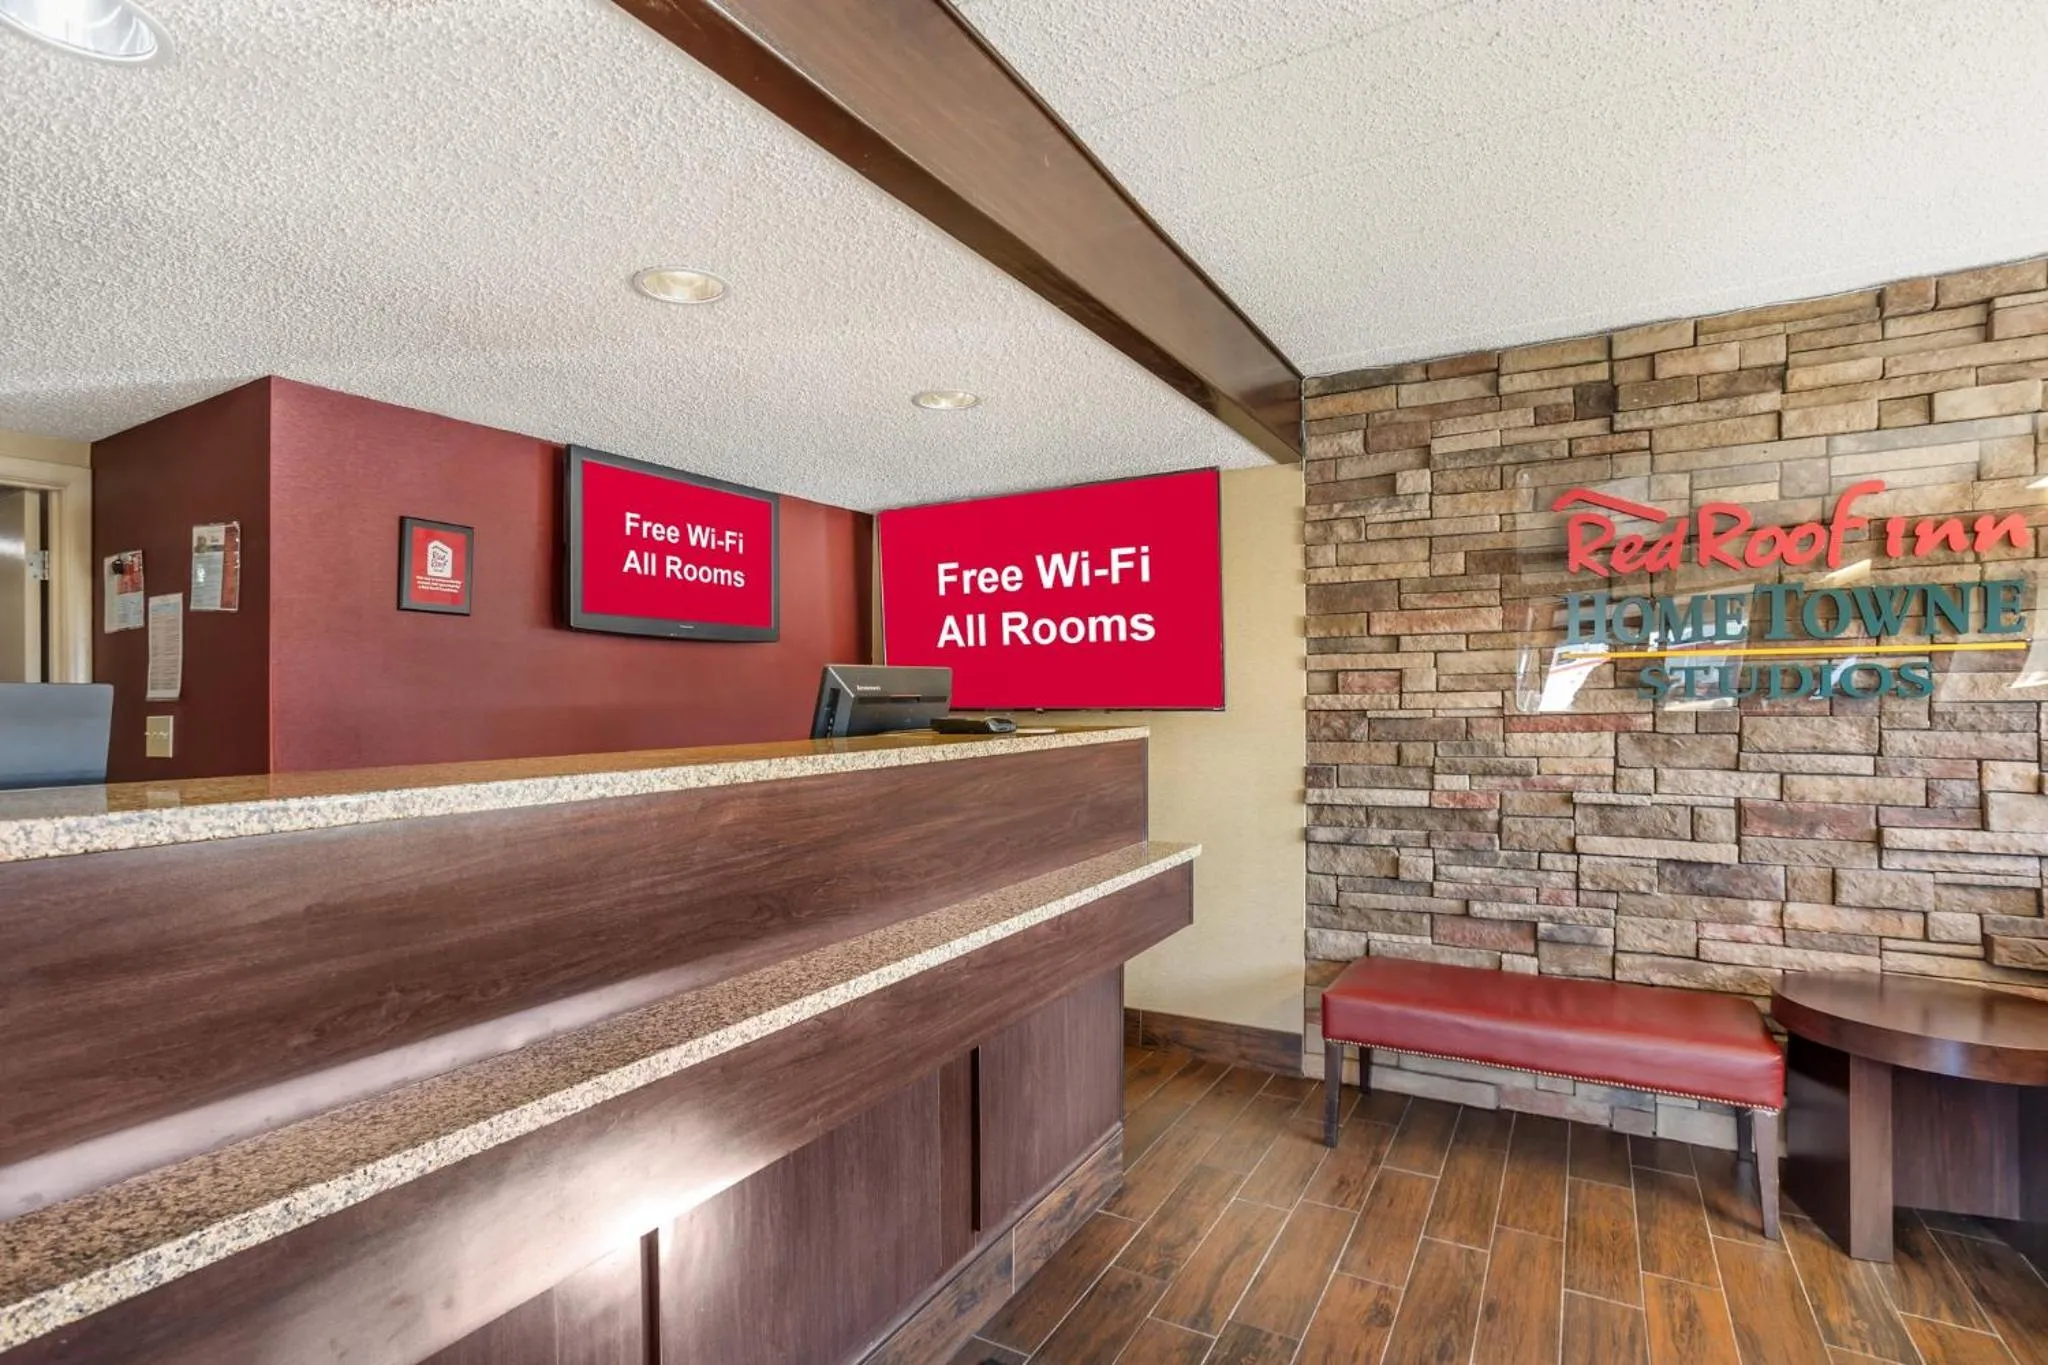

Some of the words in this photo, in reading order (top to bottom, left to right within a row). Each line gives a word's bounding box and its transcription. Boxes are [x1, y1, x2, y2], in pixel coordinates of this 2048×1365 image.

[625, 511, 680, 544] Free
[686, 523, 744, 555] Wi-Fi
[1567, 512, 1688, 577] Red
[1697, 480, 1886, 570] Roof
[622, 550, 656, 577] All
[665, 555, 745, 588] Rooms
[937, 562, 1023, 596] Free
[1035, 545, 1150, 589] Wi-Fi
[937, 614, 987, 648] All
[1002, 611, 1156, 646] Rooms
[1638, 661, 1936, 700] STUDIOS
